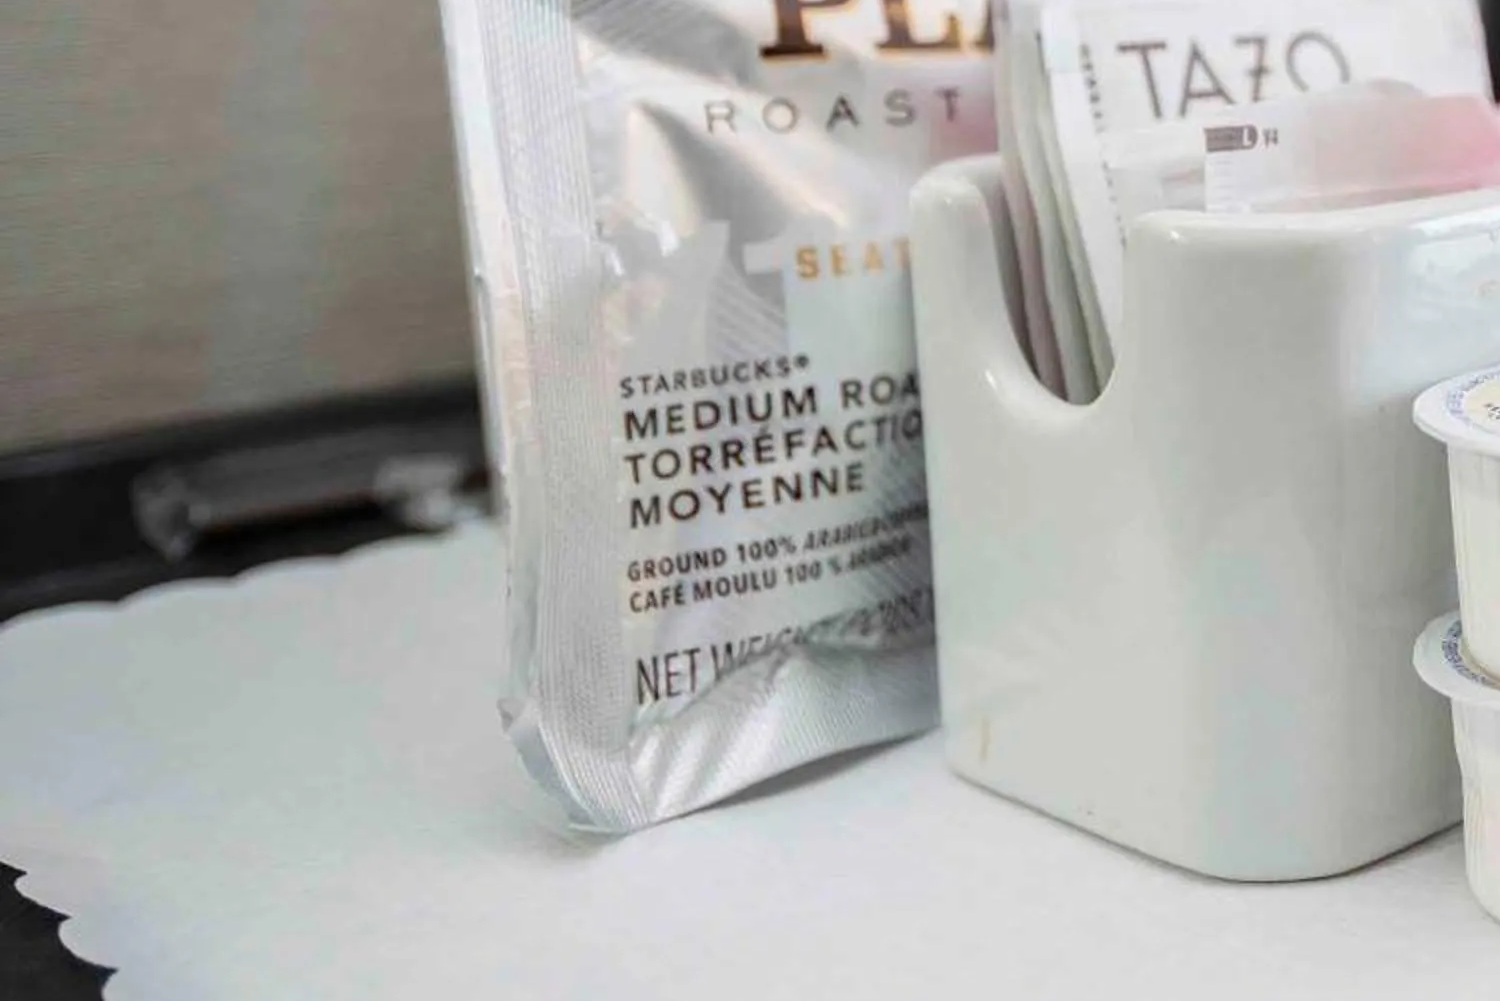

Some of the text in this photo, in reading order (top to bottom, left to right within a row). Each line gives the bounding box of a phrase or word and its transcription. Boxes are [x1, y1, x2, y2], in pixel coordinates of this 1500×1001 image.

[704, 87, 962, 134] ROAST
[796, 234, 910, 279] SEAT
[624, 372, 920, 443] MEDIUM ROA
[624, 408, 923, 485] TORRÉFACTIO
[630, 461, 866, 530] MOYENNE
[627, 547, 727, 582] GROUND
[737, 534, 797, 564] 100%
[629, 581, 686, 614] CAFÉ
[692, 568, 778, 602] MOULU
[787, 560, 821, 586] 100
[636, 647, 701, 705] NET
